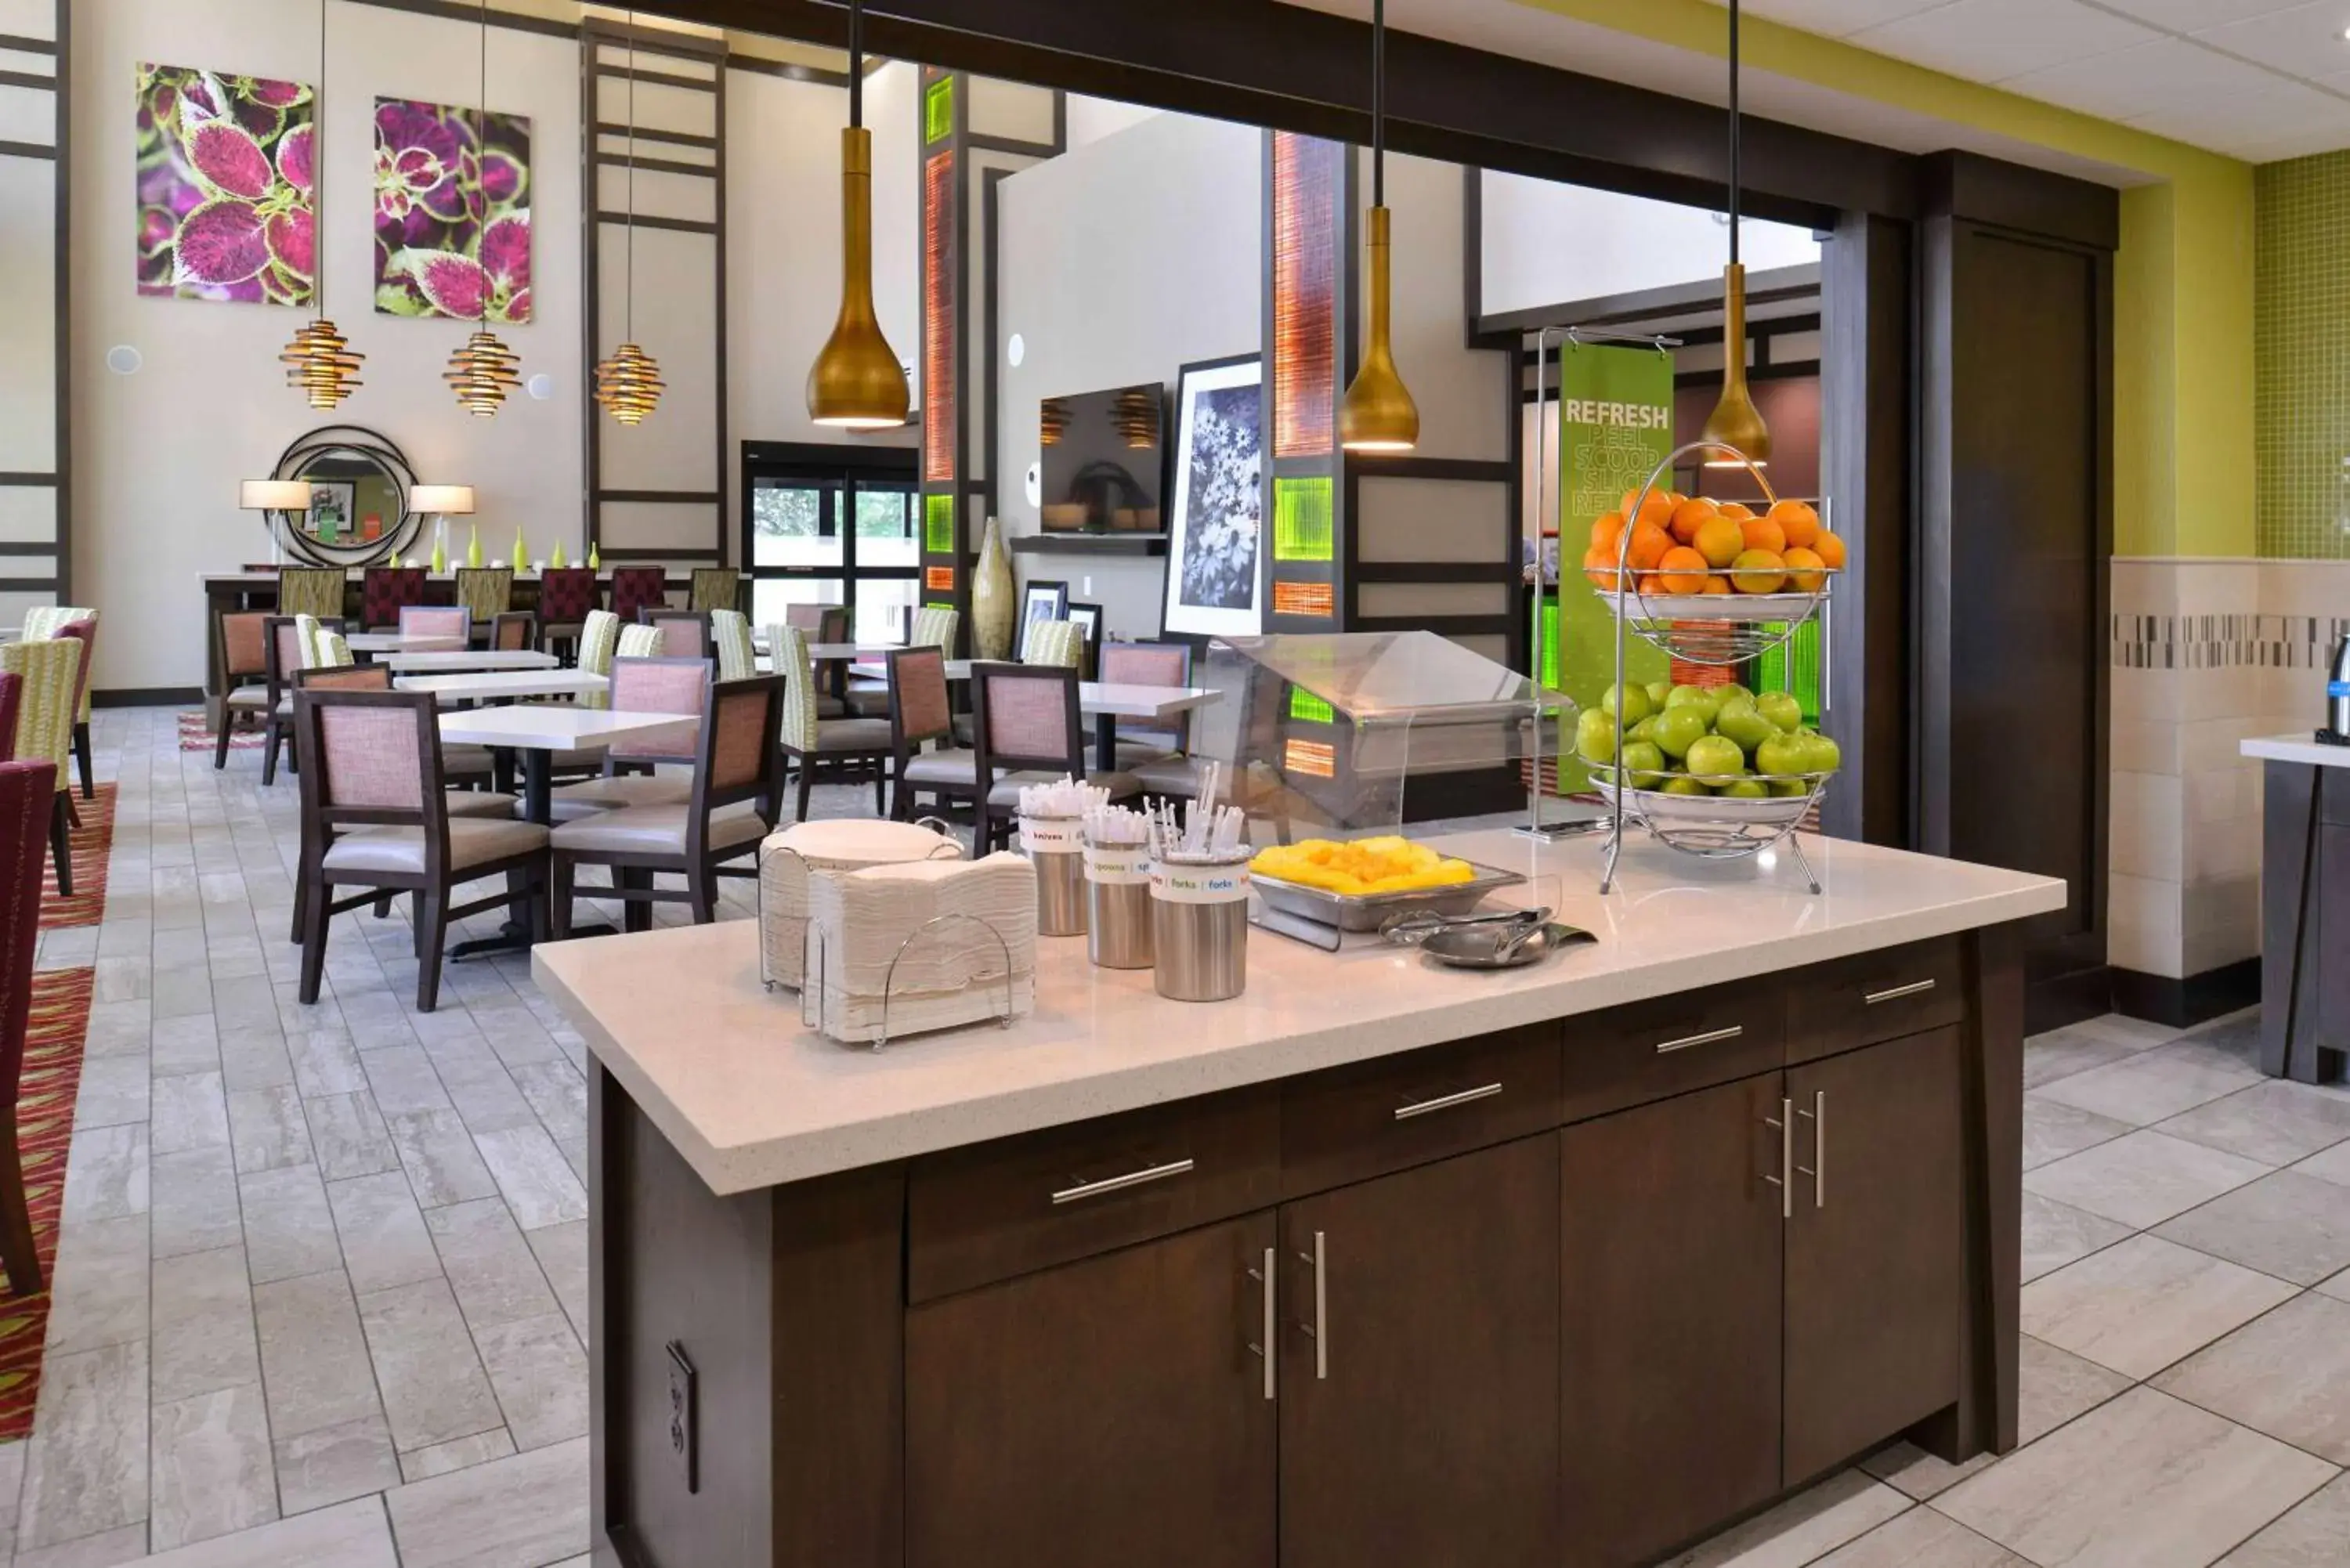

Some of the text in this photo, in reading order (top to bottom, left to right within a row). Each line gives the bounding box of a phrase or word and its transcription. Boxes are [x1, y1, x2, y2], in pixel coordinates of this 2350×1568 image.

[1566, 399, 1668, 430] REFRESH
[1588, 424, 1647, 448] PEEL
[1574, 444, 1660, 471] SCOOP
[1033, 831, 1063, 840] knives
[1171, 878, 1197, 889] forks
[1209, 879, 1232, 890] forks
